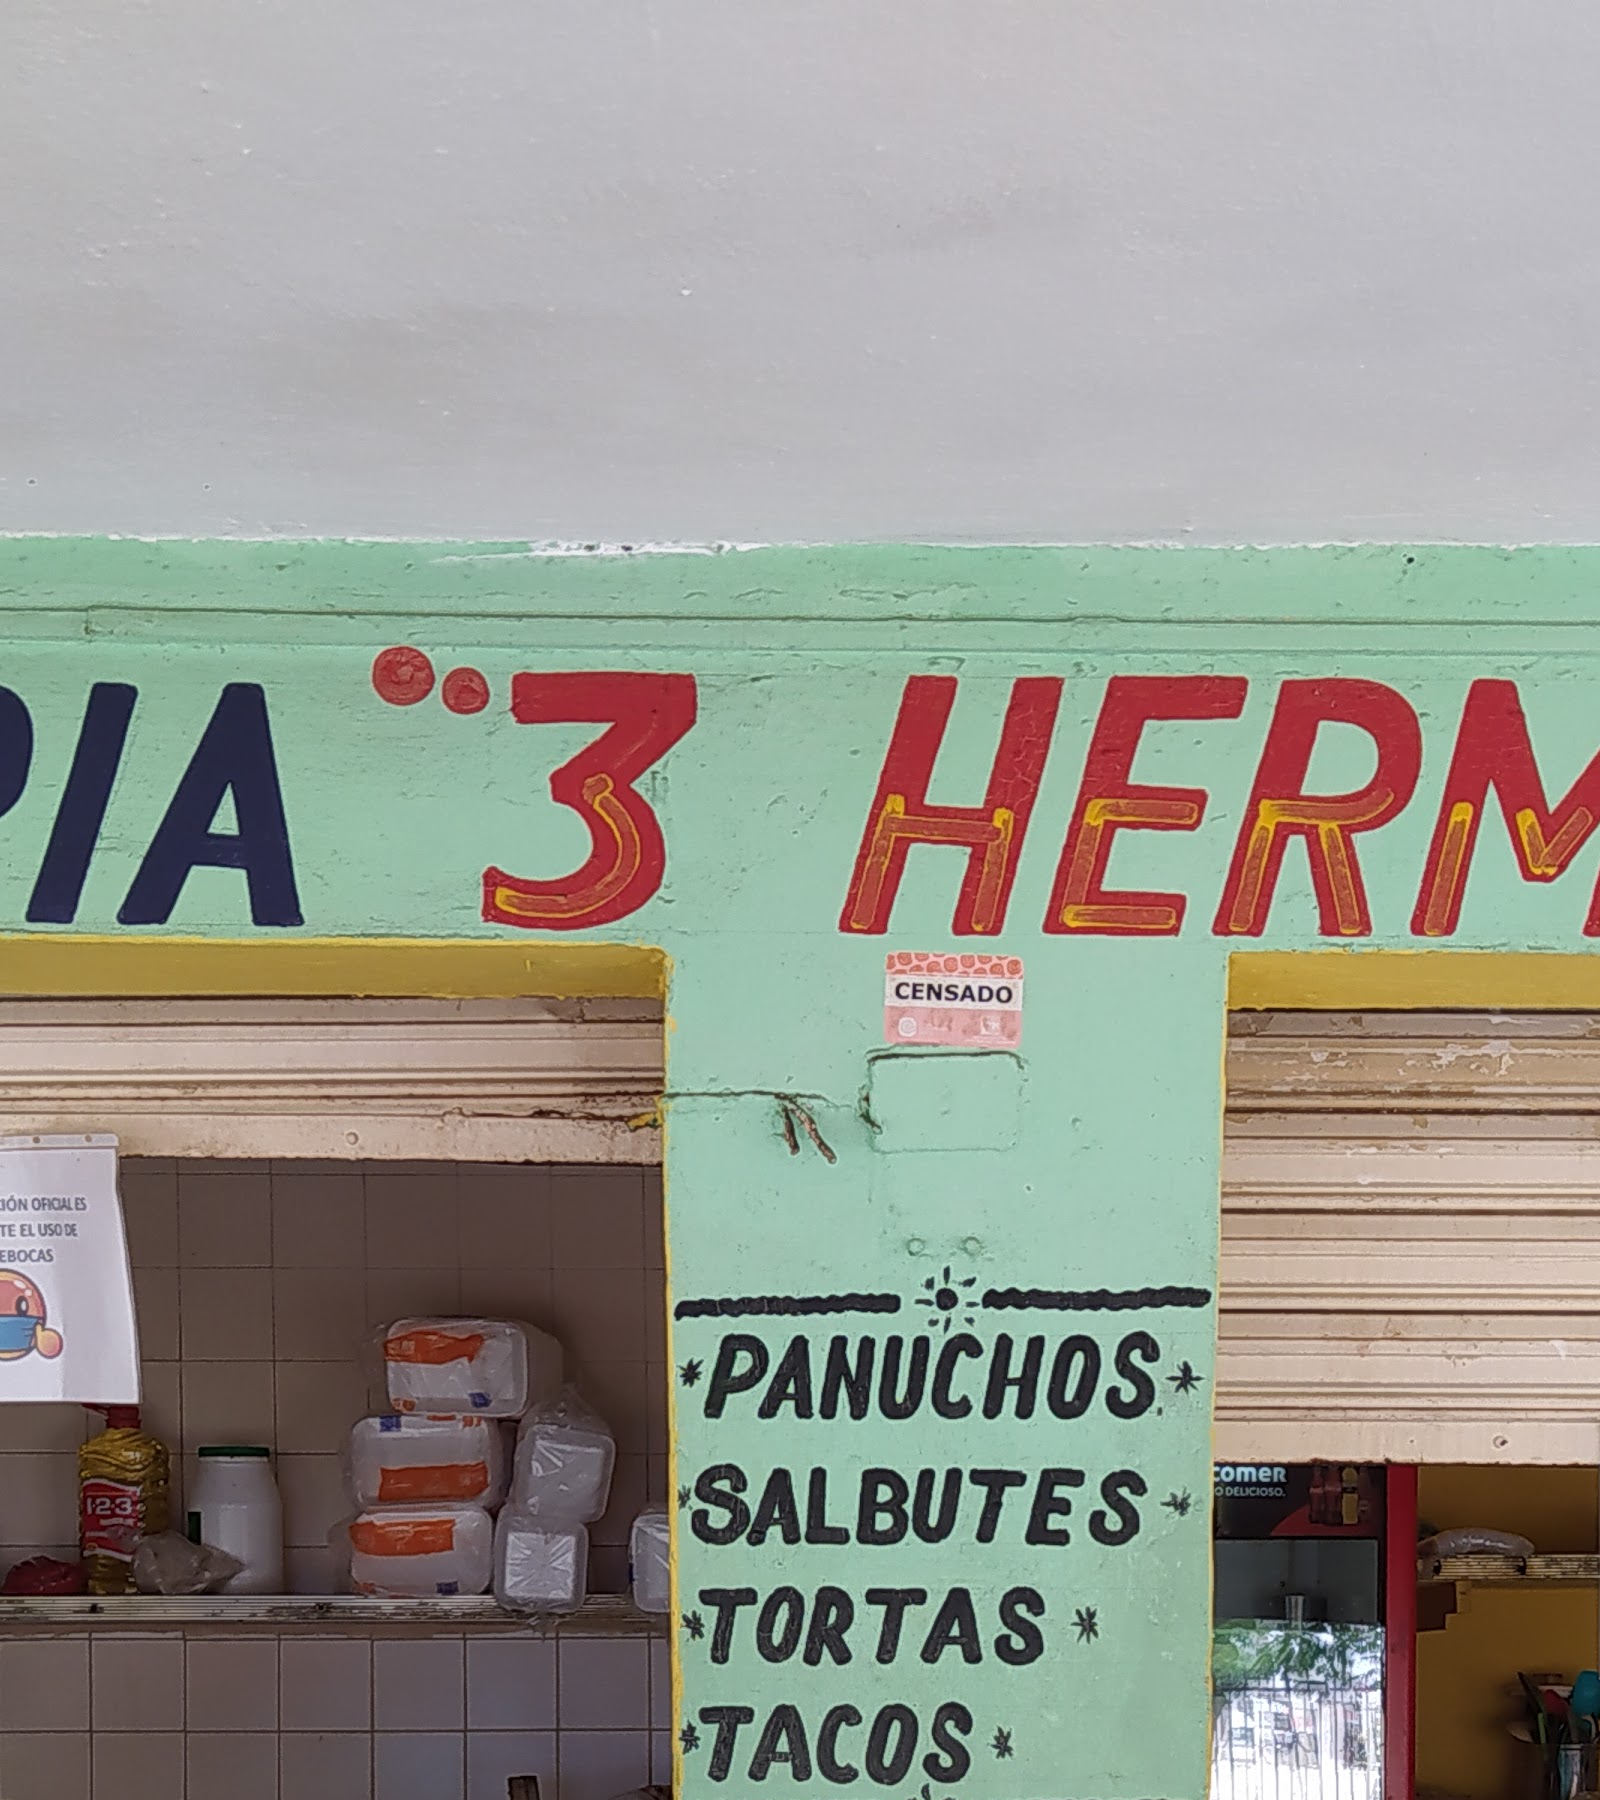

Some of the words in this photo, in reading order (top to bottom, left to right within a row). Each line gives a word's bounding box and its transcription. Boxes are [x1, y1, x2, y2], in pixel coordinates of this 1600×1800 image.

[895, 982, 1013, 1004] CENSADO
[20, 1224, 35, 1236] EL
[38, 1223, 63, 1236] USO
[64, 1223, 78, 1236] DE
[703, 1331, 1160, 1420] PANUCHOS
[692, 1464, 1148, 1546] SALBUTES
[1226, 1486, 1287, 1497] DELICIOSO.
[699, 1587, 1045, 1667] TORTAS
[699, 1702, 973, 1785] TACOS
